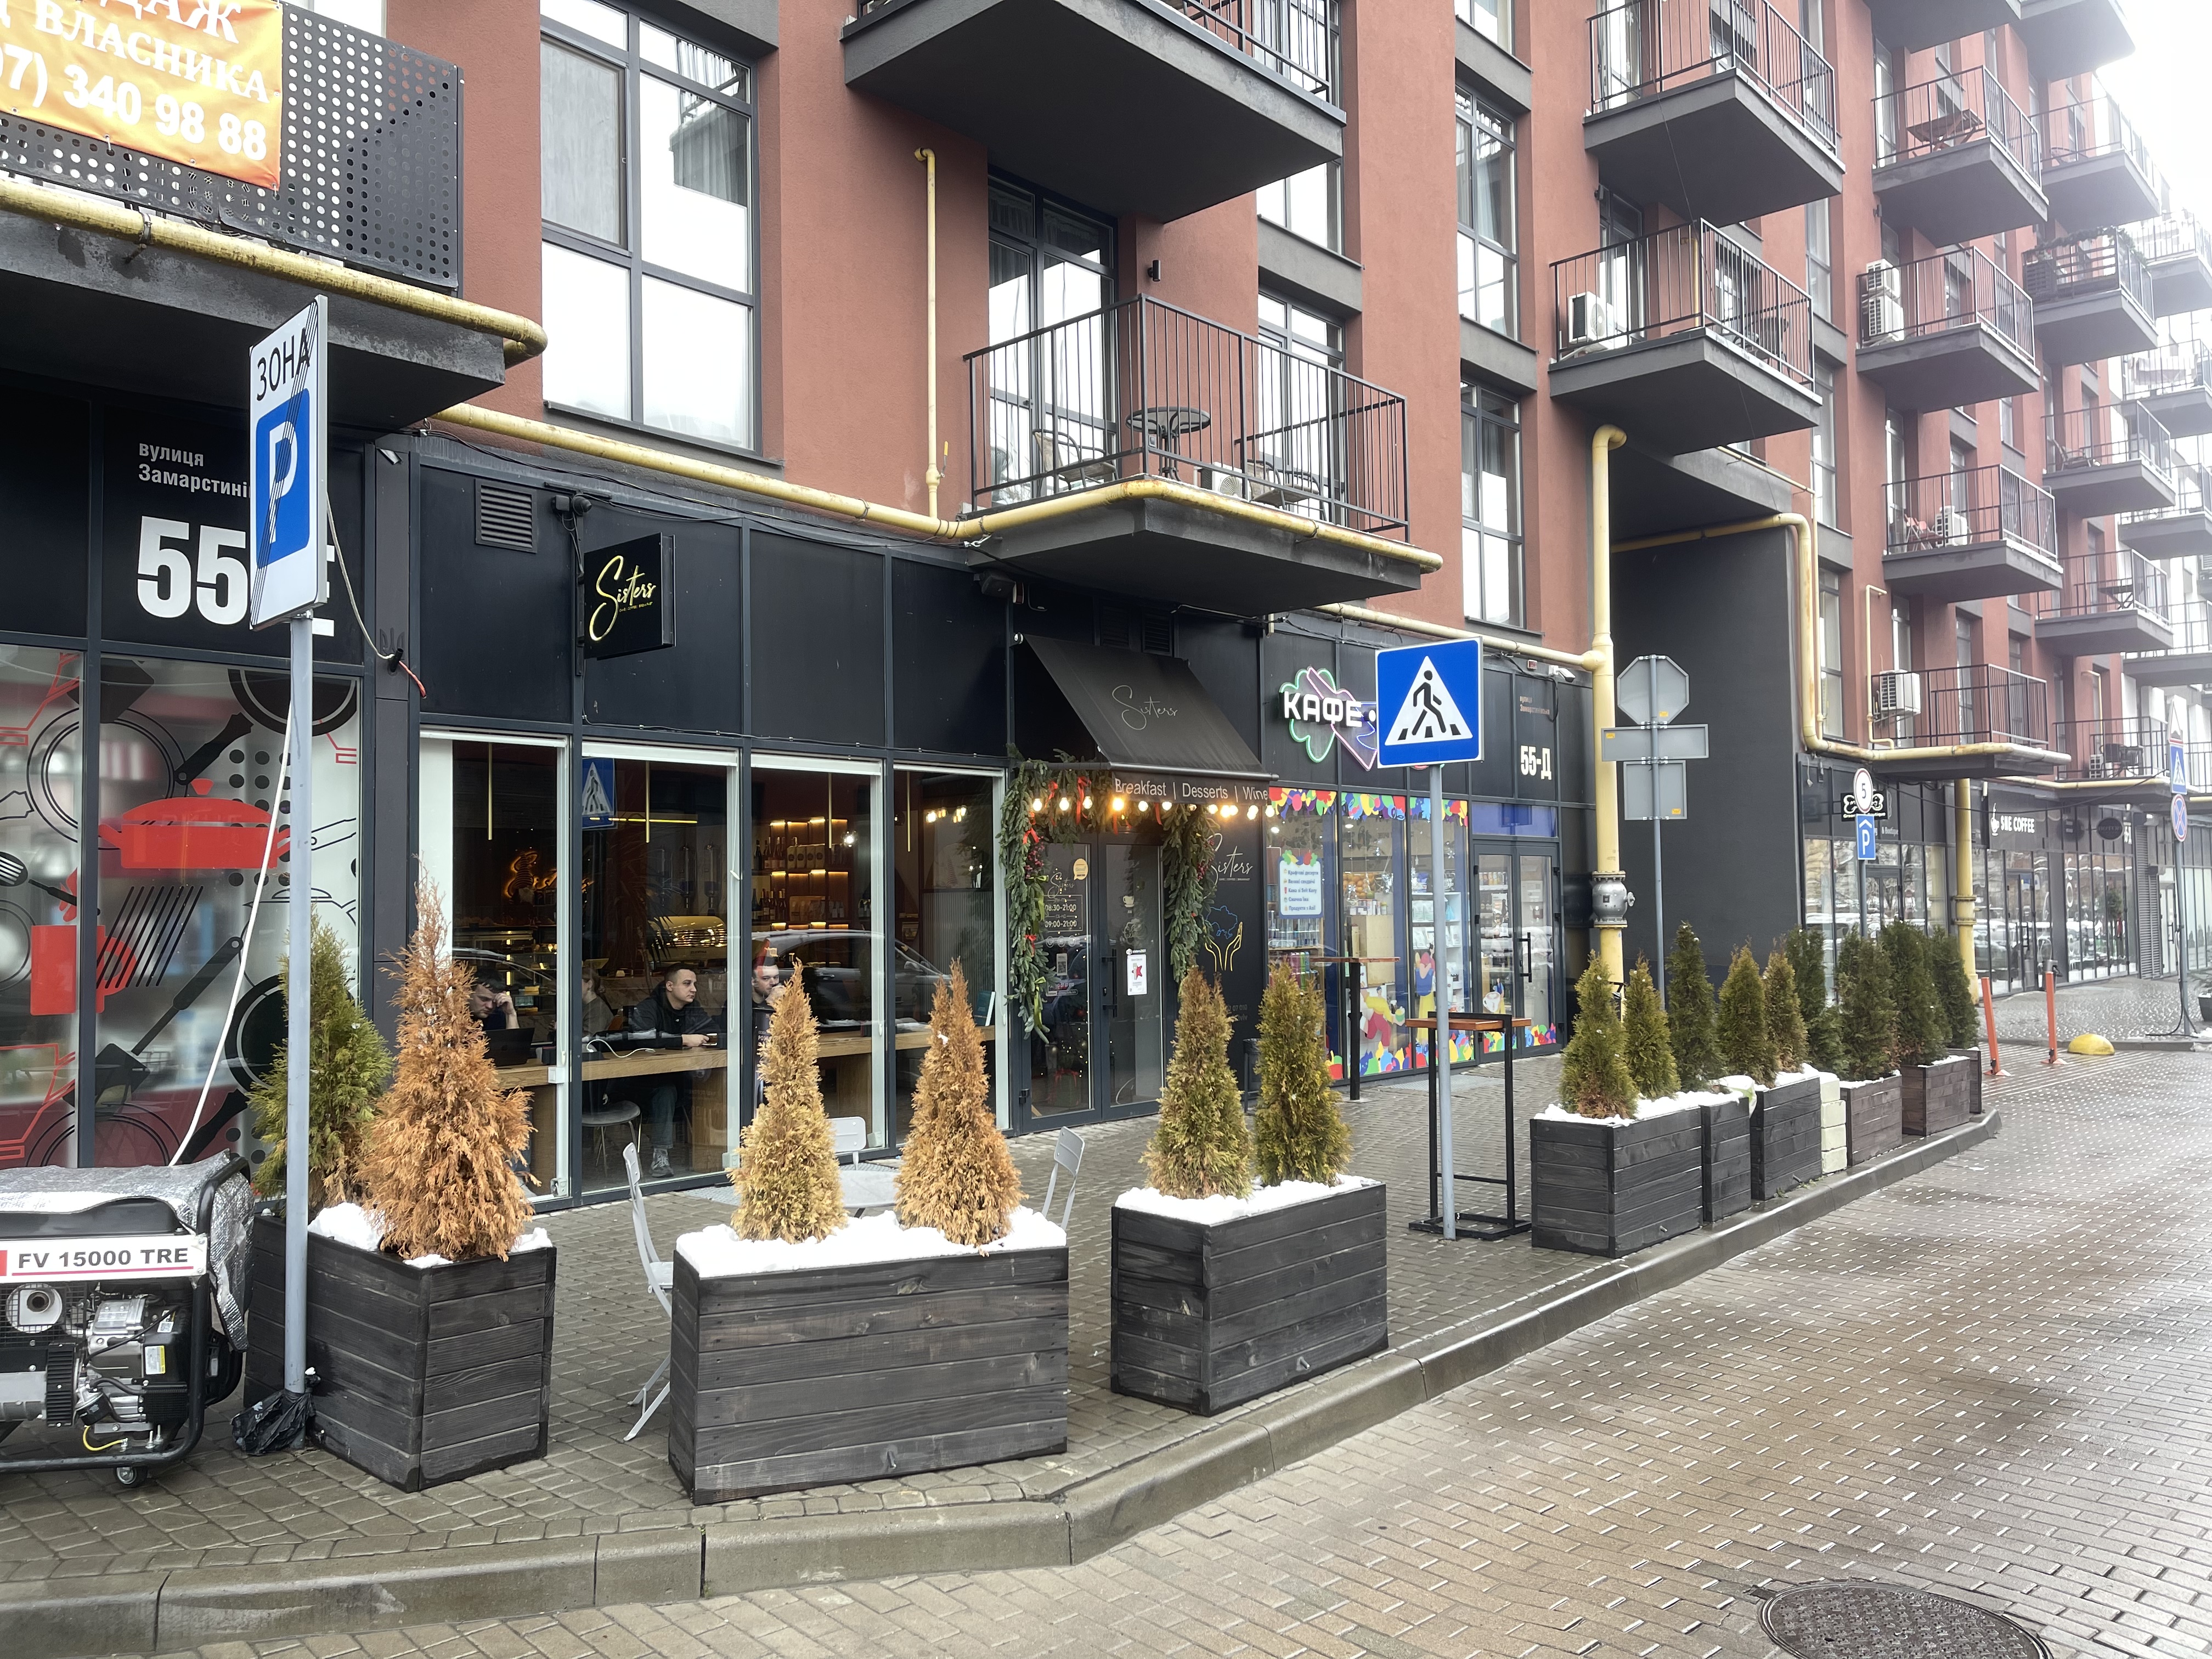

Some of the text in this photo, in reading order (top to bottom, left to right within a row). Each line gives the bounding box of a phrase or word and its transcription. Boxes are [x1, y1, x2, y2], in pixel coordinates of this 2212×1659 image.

[35, 0, 270, 104] ВЛАСНИКА
[0, 43, 267, 161] 7) 340 98 88
[256, 328, 311, 402] ЗОНА
[139, 443, 204, 467] вулиця
[138, 464, 250, 499] Замарстині
[269, 421, 298, 545] P
[589, 555, 657, 642] Sisters
[1111, 685, 1178, 730] Sisters
[1284, 691, 1363, 727] КАФЕ
[1520, 745, 1552, 780] 55-Д
[1115, 778, 1166, 796] Breakfast
[1182, 782, 1228, 799] Desserts
[1243, 786, 1268, 800] Wine
[1861, 783, 1866, 799] 5
[2013, 816, 2035, 833] COFFEE
[1861, 829, 1870, 856] P
[19, 1248, 189, 1269] FV 15000 TRE
